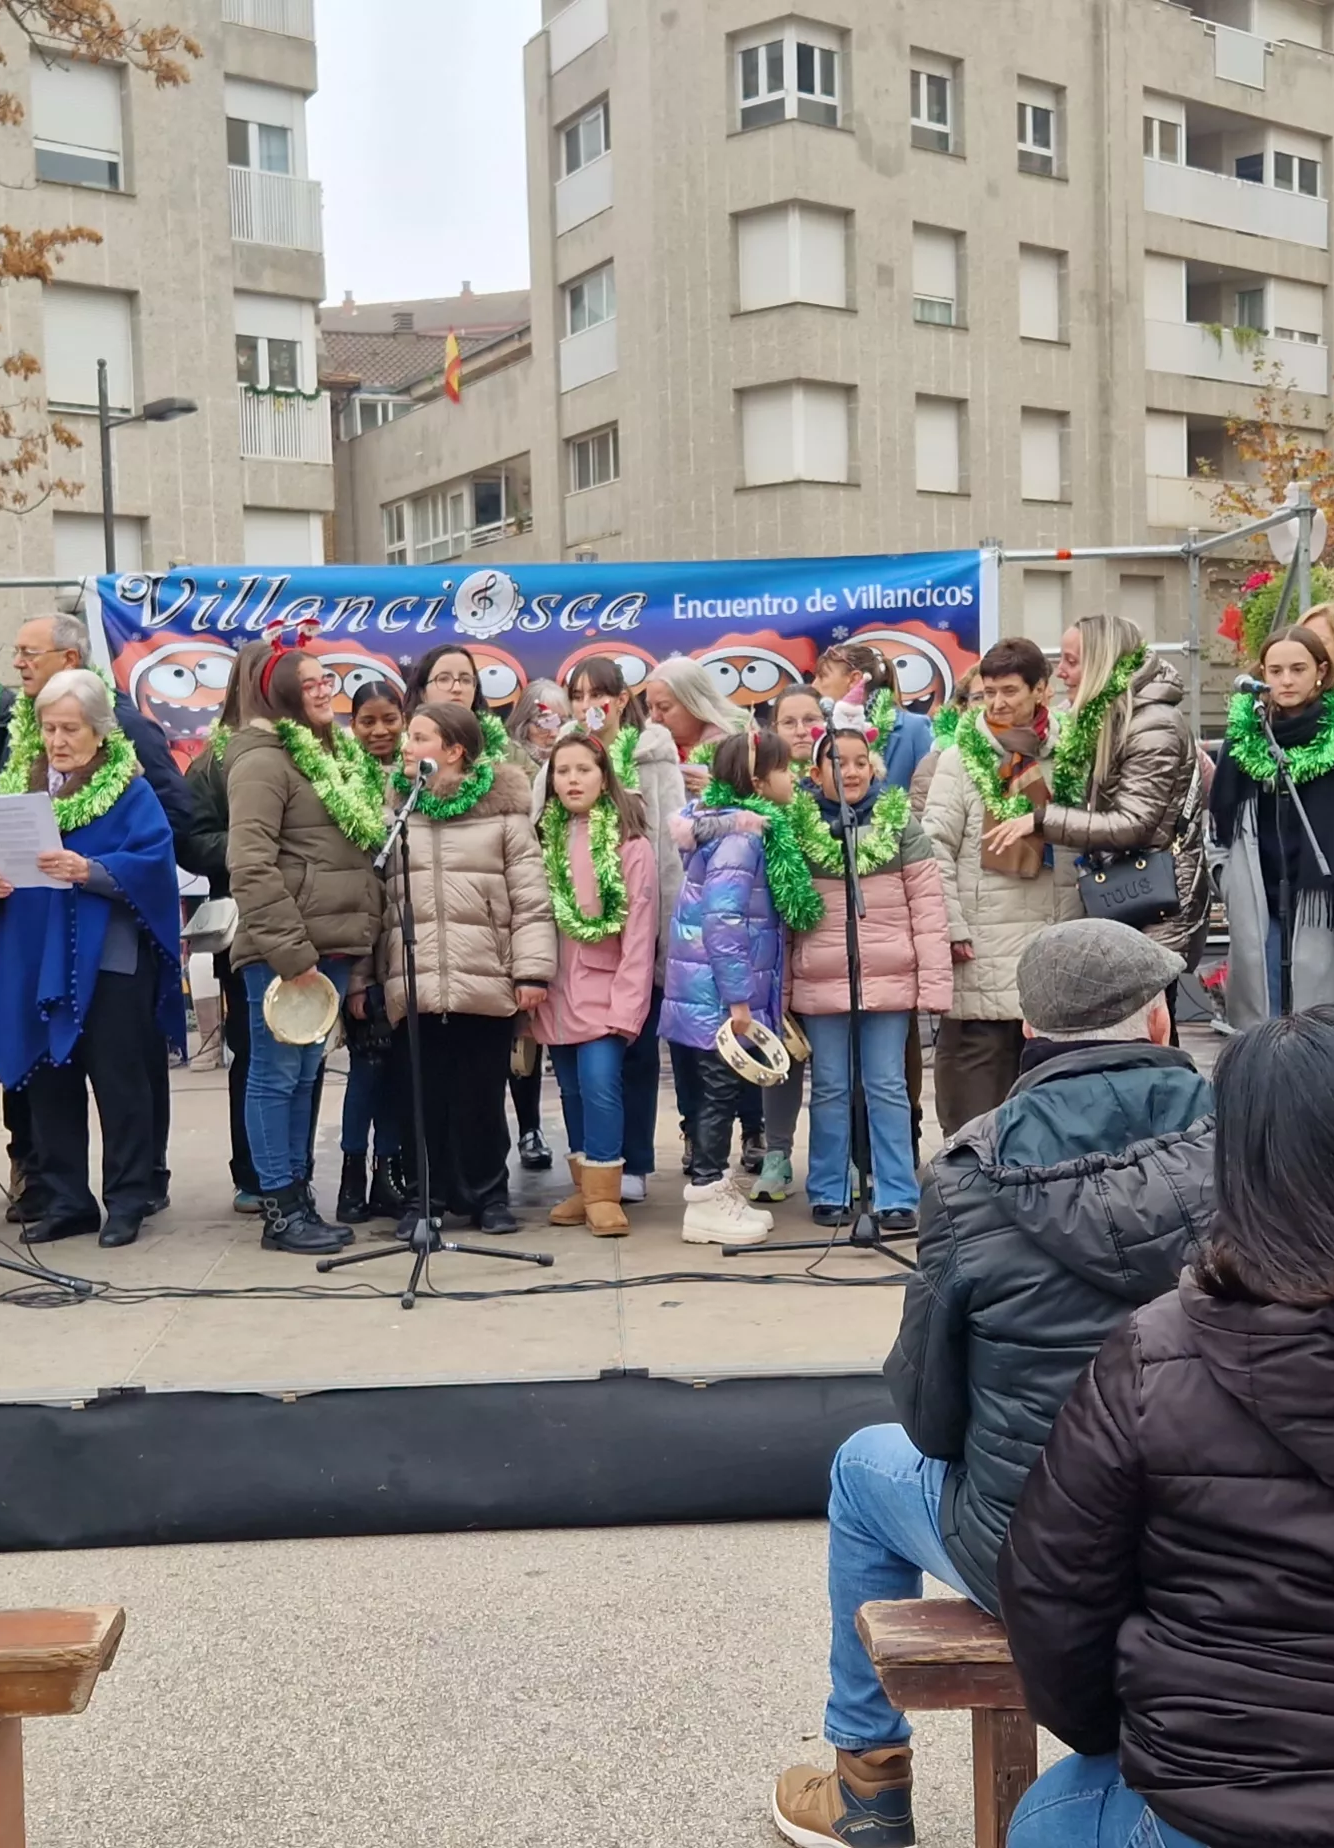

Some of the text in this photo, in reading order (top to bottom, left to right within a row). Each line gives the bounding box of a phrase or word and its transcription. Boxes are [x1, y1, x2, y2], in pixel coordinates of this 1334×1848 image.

[673, 579, 974, 619] Encuentro de Villancicos
[1100, 878, 1153, 907] TOUS
